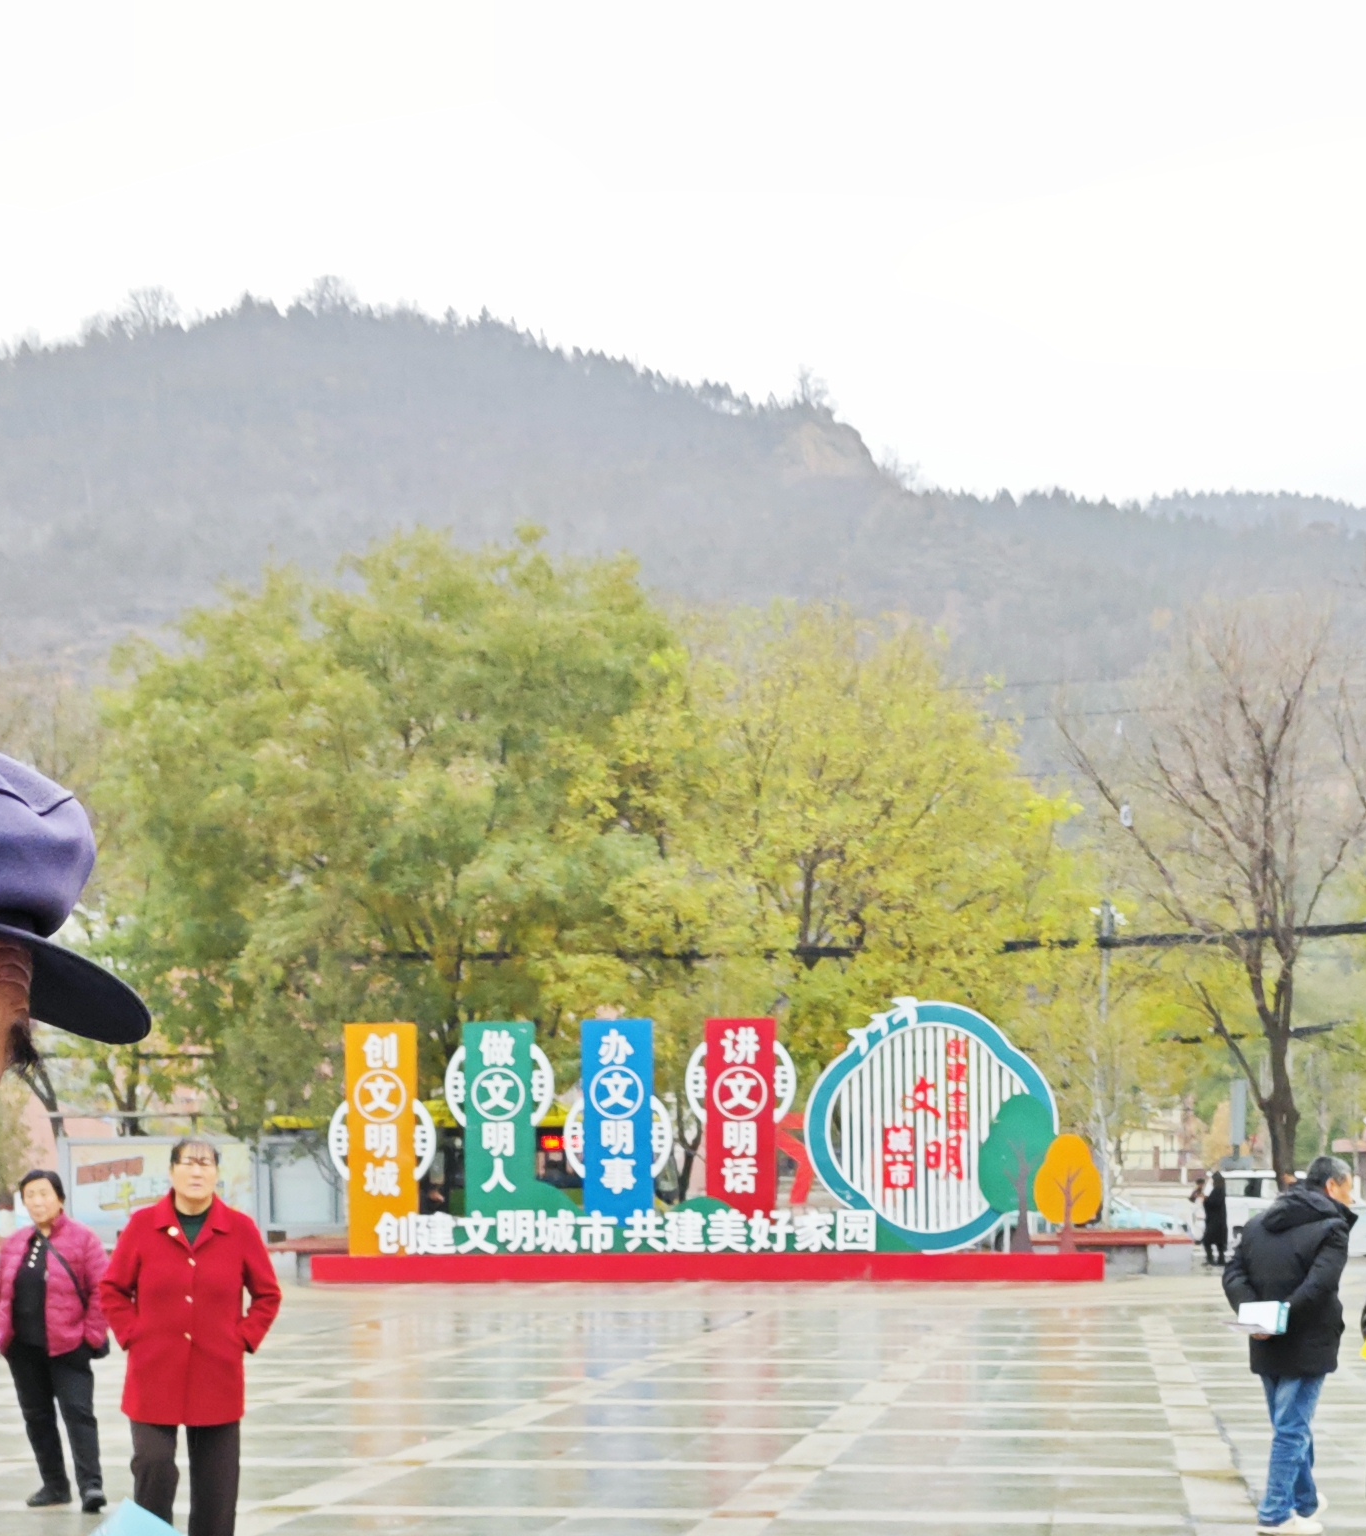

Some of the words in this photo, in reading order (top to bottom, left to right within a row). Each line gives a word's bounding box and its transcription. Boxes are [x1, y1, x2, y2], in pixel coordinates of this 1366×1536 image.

[362, 1032, 402, 1198] 创文明城
[479, 1029, 517, 1194] 做文明人
[598, 1028, 637, 1195] 办文明事
[720, 1027, 761, 1195] 讲文明话
[884, 1127, 914, 1189] 城市
[374, 1209, 619, 1255] 创建文明城市
[623, 1208, 877, 1254] 共建美好家园
